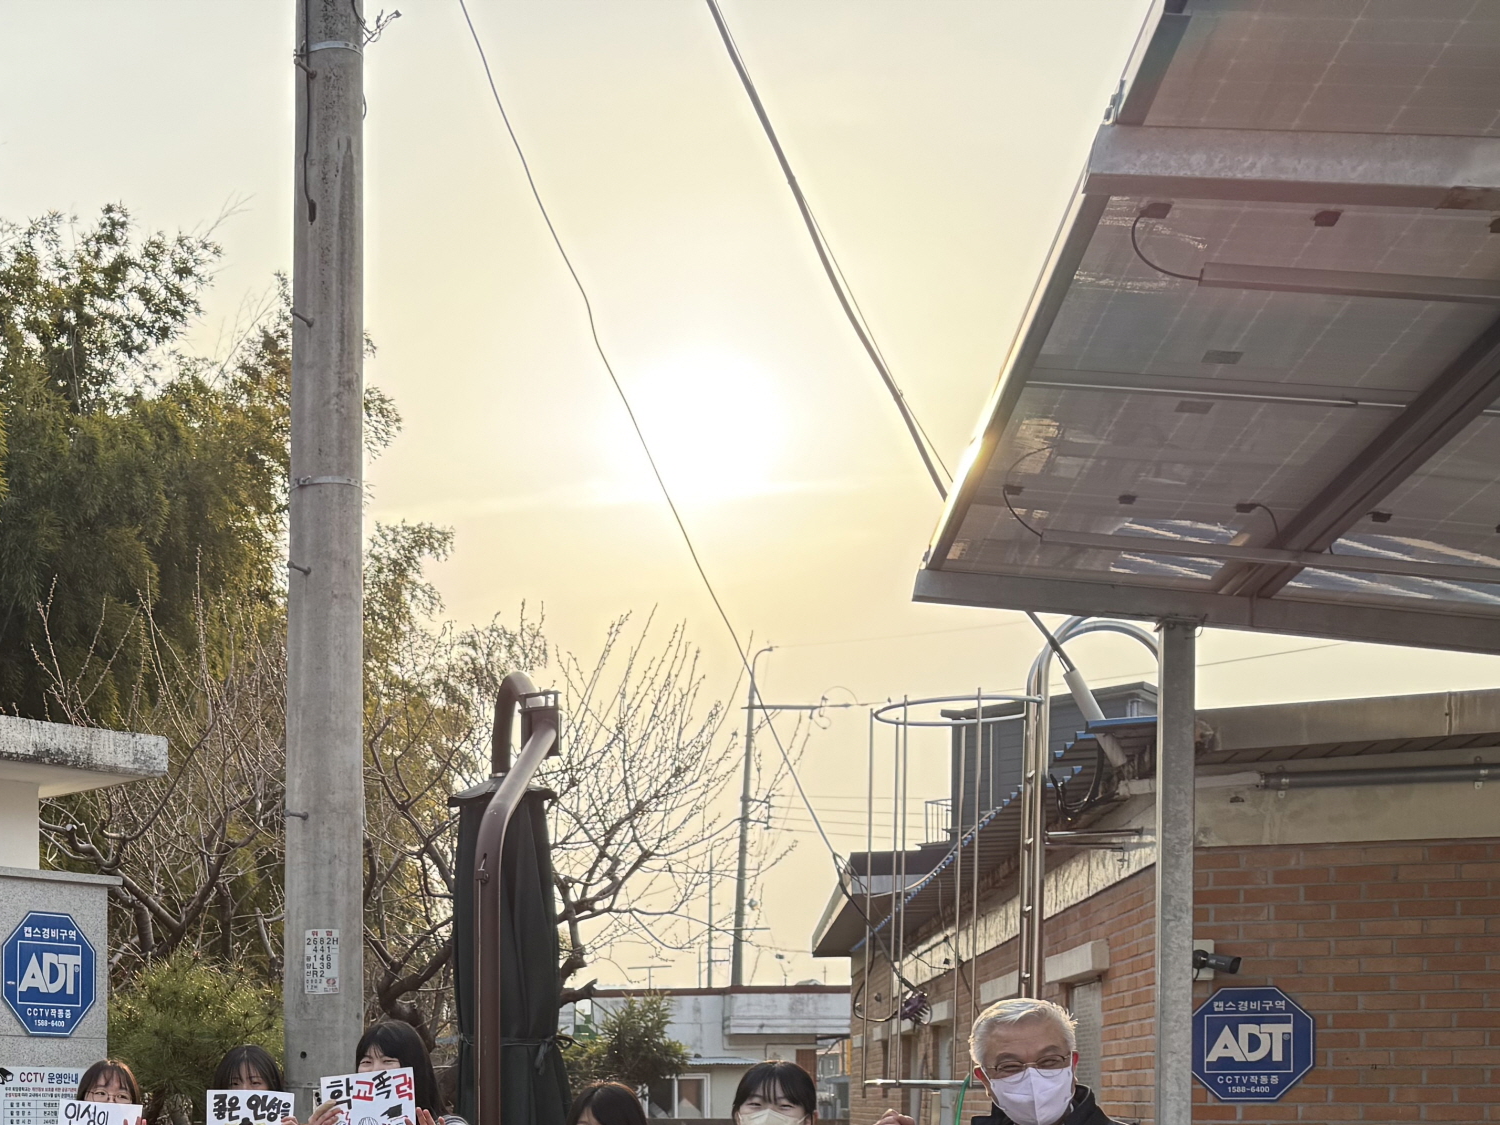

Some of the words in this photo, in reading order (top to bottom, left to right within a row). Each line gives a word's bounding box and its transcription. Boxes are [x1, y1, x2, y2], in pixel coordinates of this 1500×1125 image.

[24, 926, 77, 941] 캡스경비구역
[19, 953, 80, 994] ADT
[1213, 1000, 1286, 1012] 캡스경비구역
[27, 1007, 71, 1019] CCTV작동중
[1205, 1023, 1292, 1062] ADT
[19, 1072, 45, 1083] CCTV
[47, 1072, 79, 1085] 운영안내
[1217, 1075, 1279, 1084] CCTV작동중
